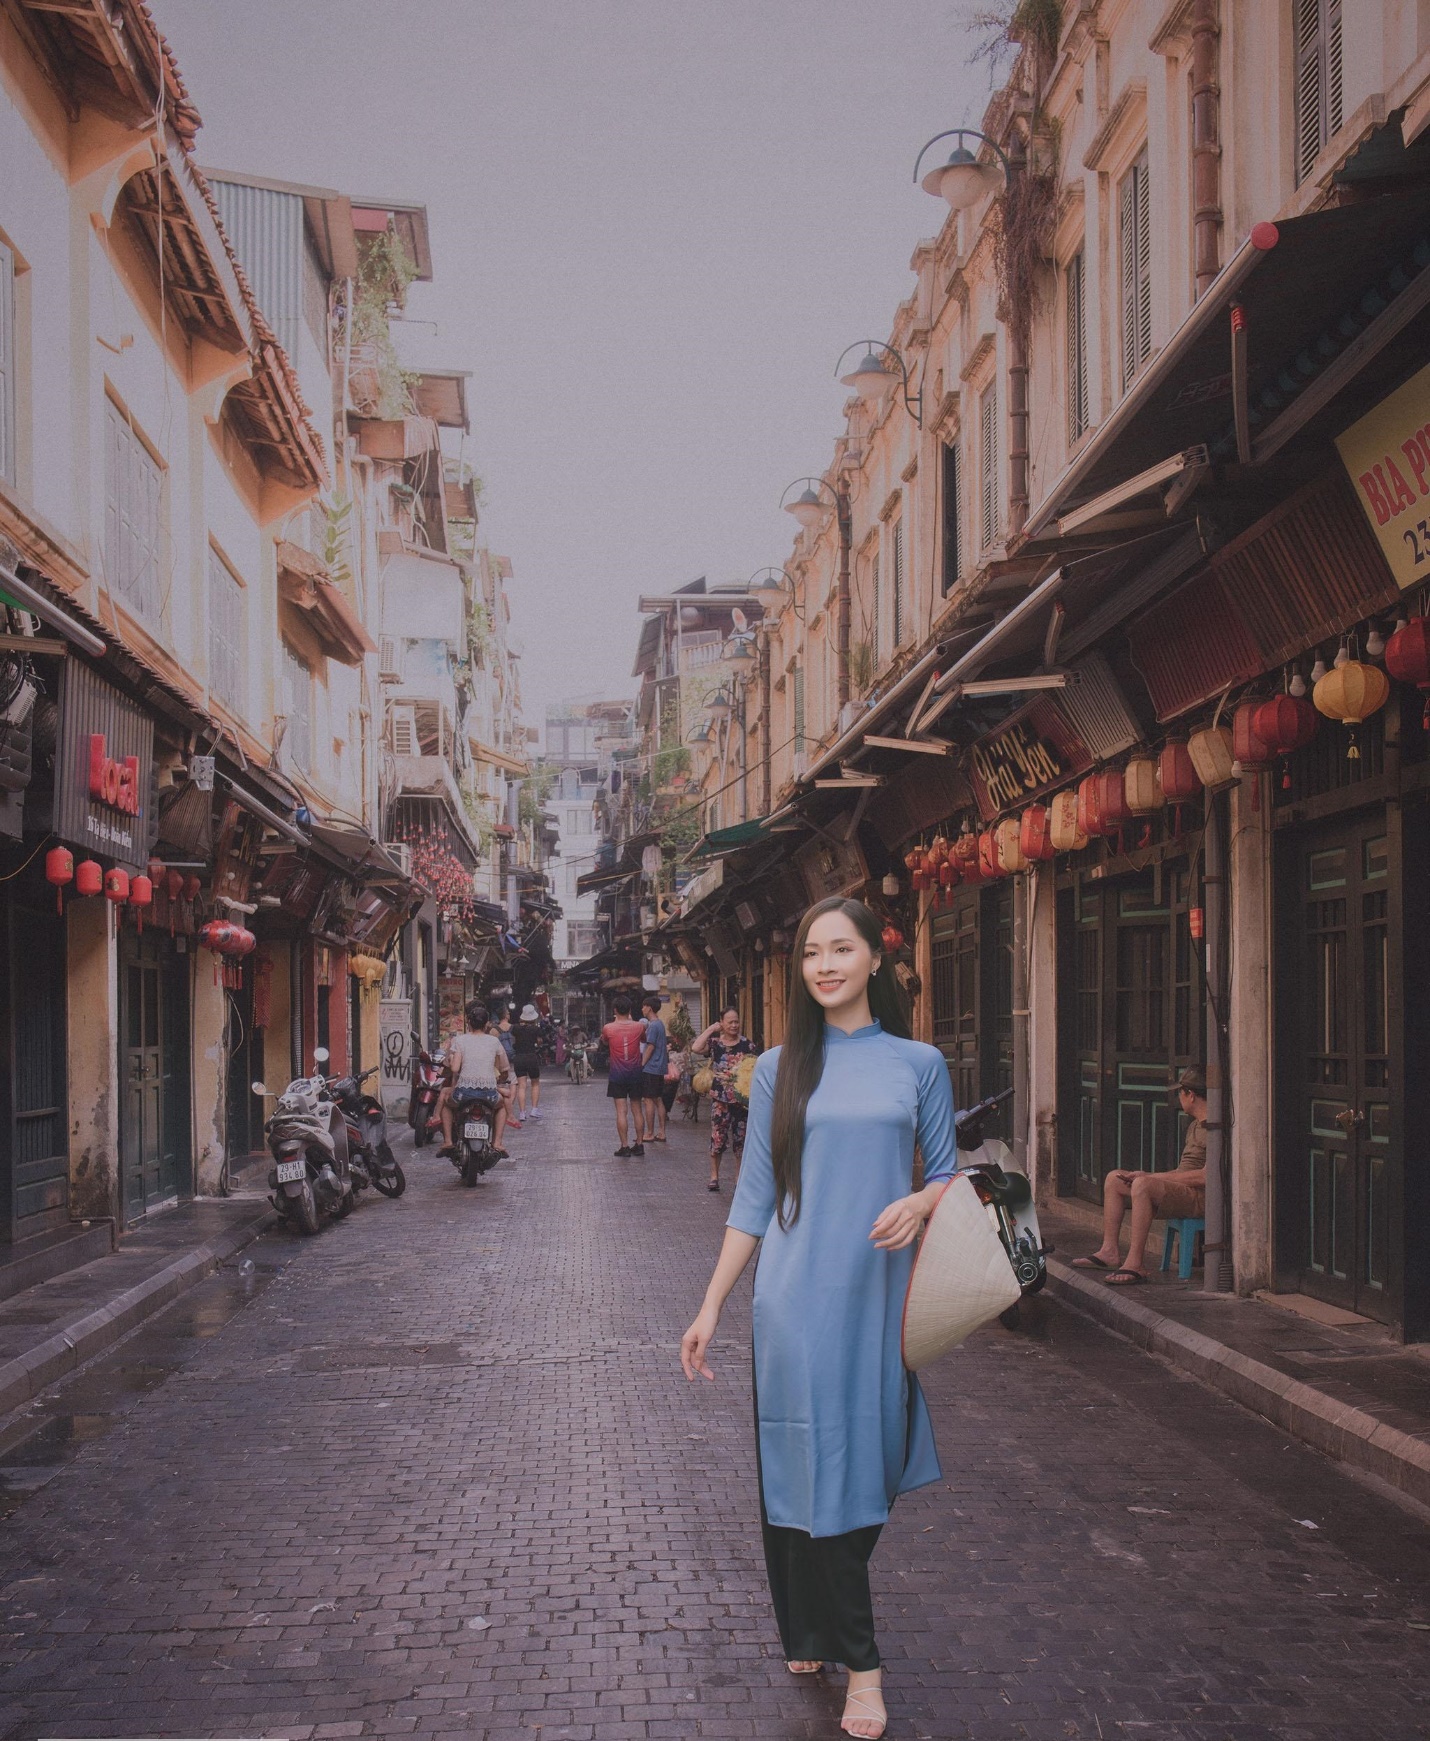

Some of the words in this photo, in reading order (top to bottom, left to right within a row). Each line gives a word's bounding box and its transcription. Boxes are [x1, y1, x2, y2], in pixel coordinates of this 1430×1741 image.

[1359, 456, 1417, 526] BIA
[281, 1161, 300, 1173] 29-H1
[280, 1170, 304, 1181] 934.80
